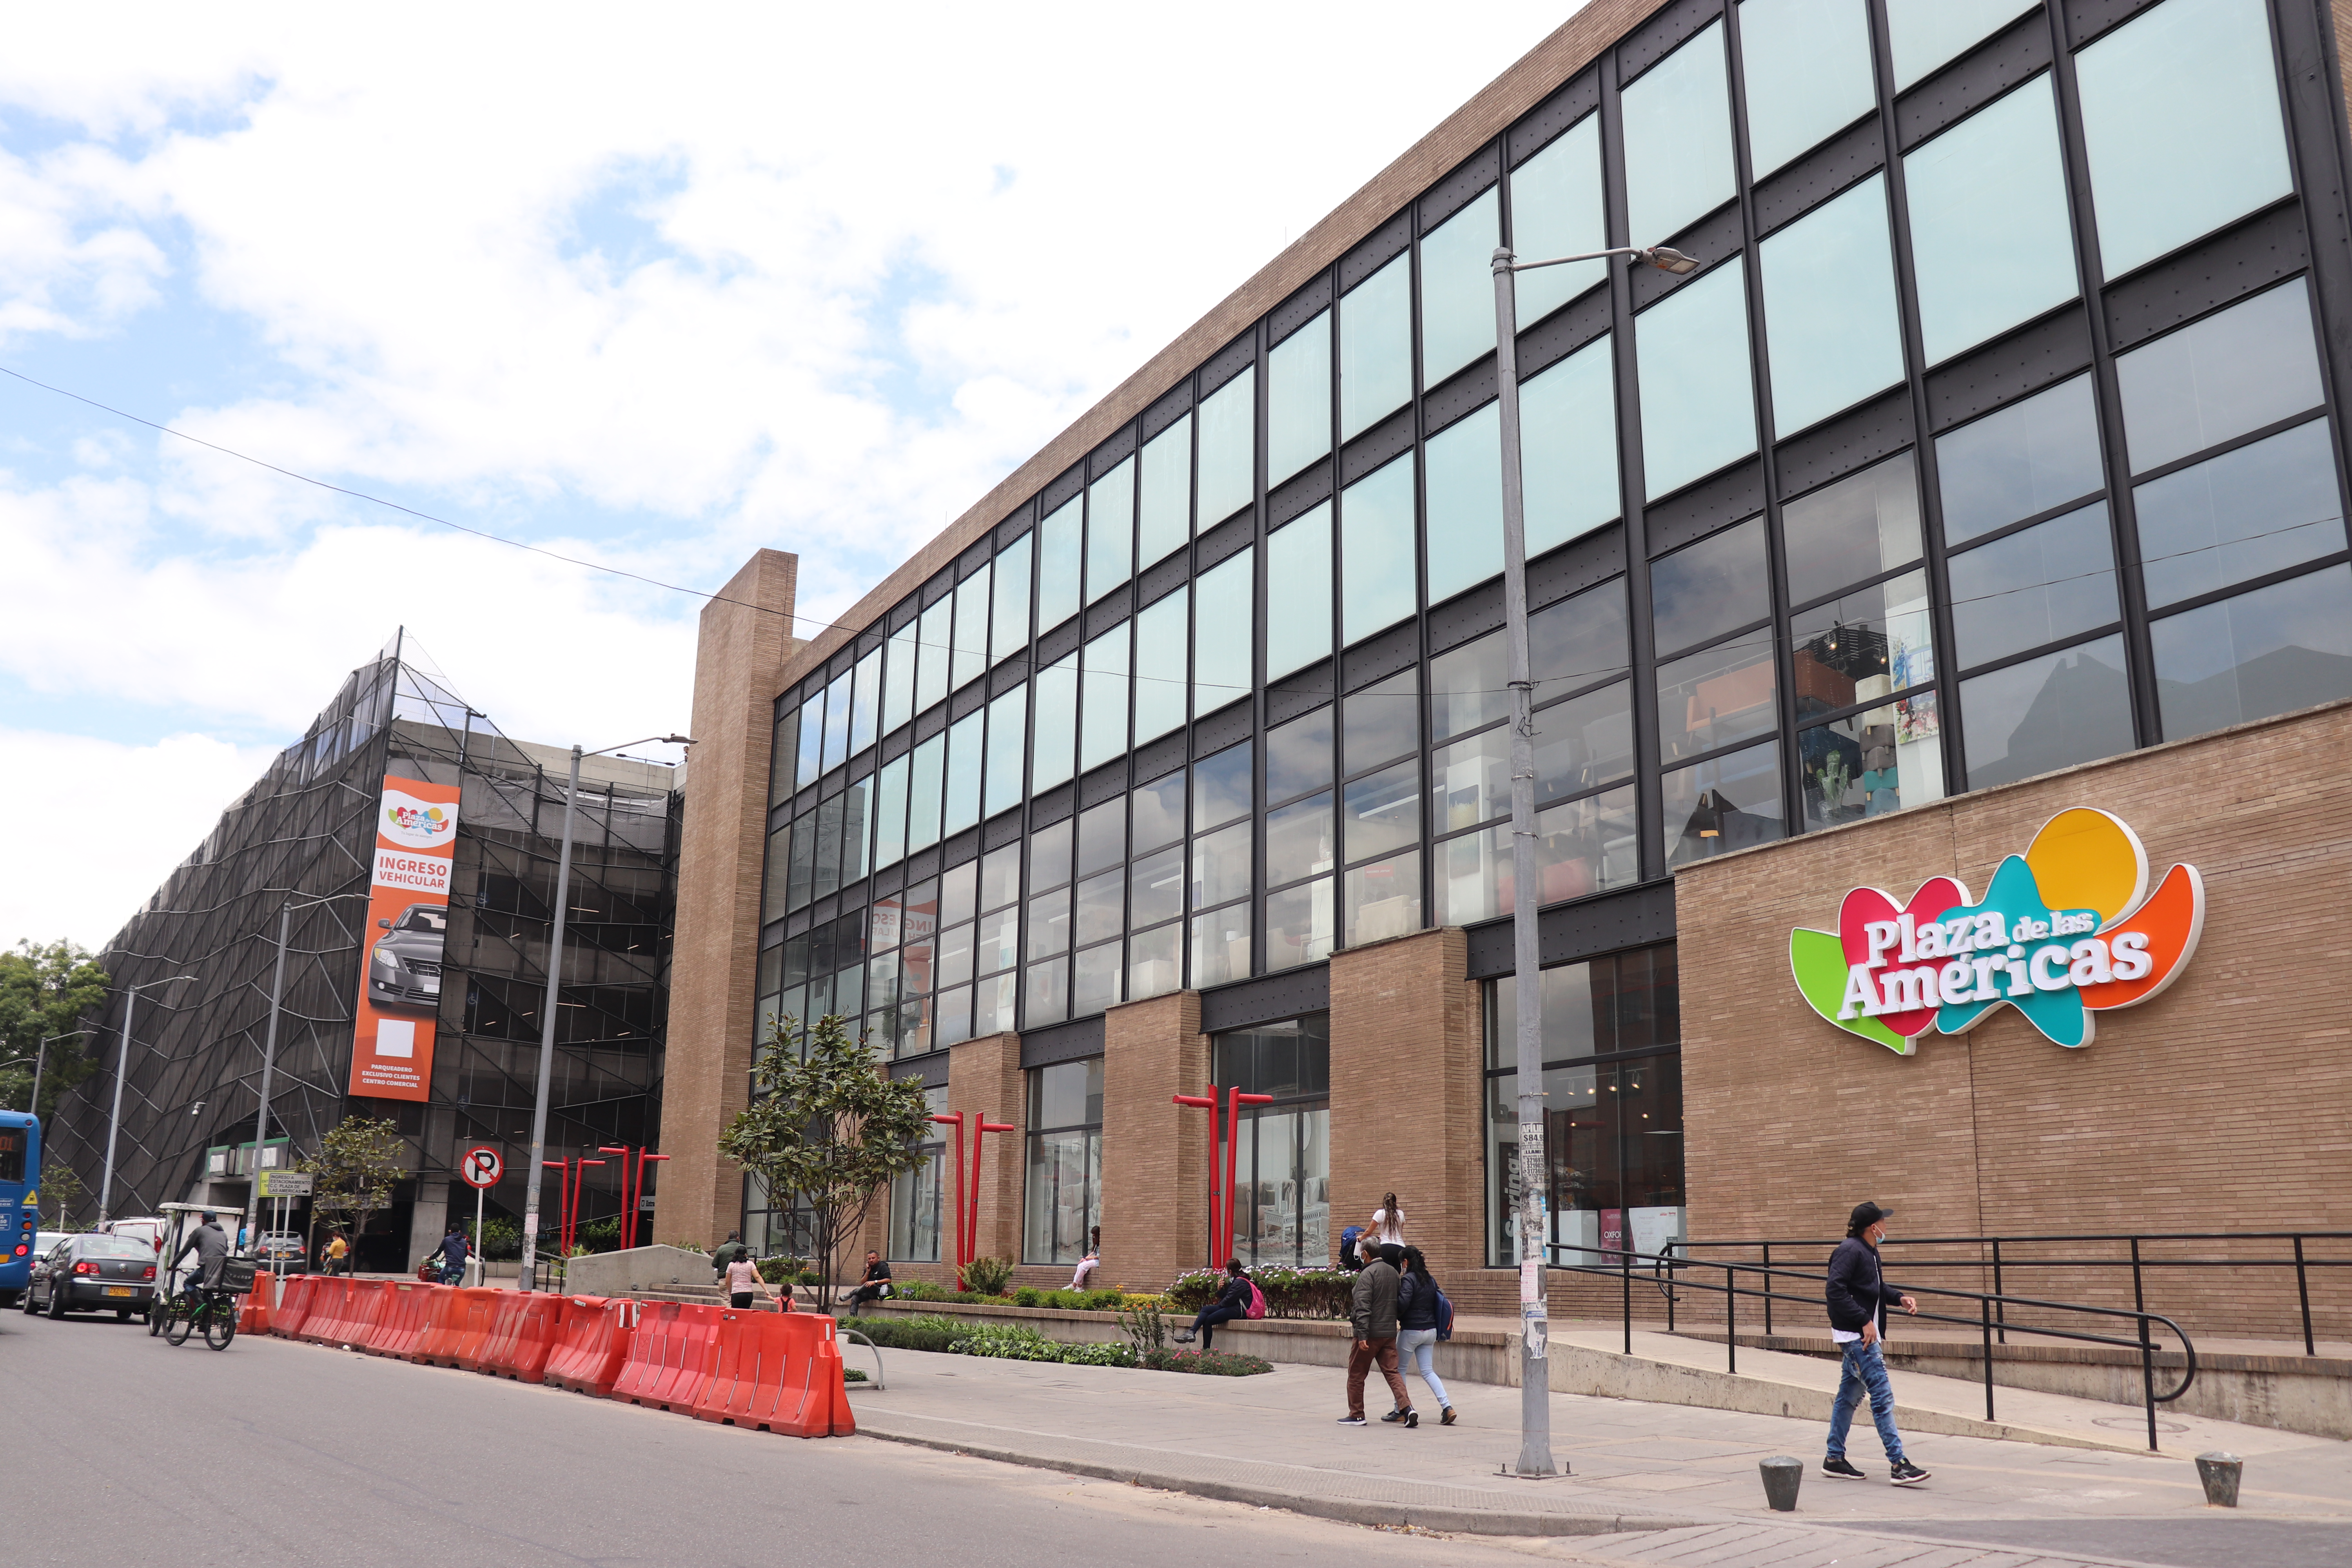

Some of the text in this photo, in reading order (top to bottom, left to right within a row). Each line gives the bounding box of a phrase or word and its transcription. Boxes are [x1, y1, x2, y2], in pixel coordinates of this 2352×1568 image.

[395, 816, 443, 830] Américas
[402, 811, 425, 822] Plaza
[379, 856, 447, 876] INGRESO
[379, 871, 445, 888] VEHICULAR
[1864, 911, 2094, 969] Plaza de las
[1837, 931, 2152, 1020] Américas
[362, 1071, 392, 1079] EXCLUSIVO
[371, 1064, 413, 1073] PARQUEADERO
